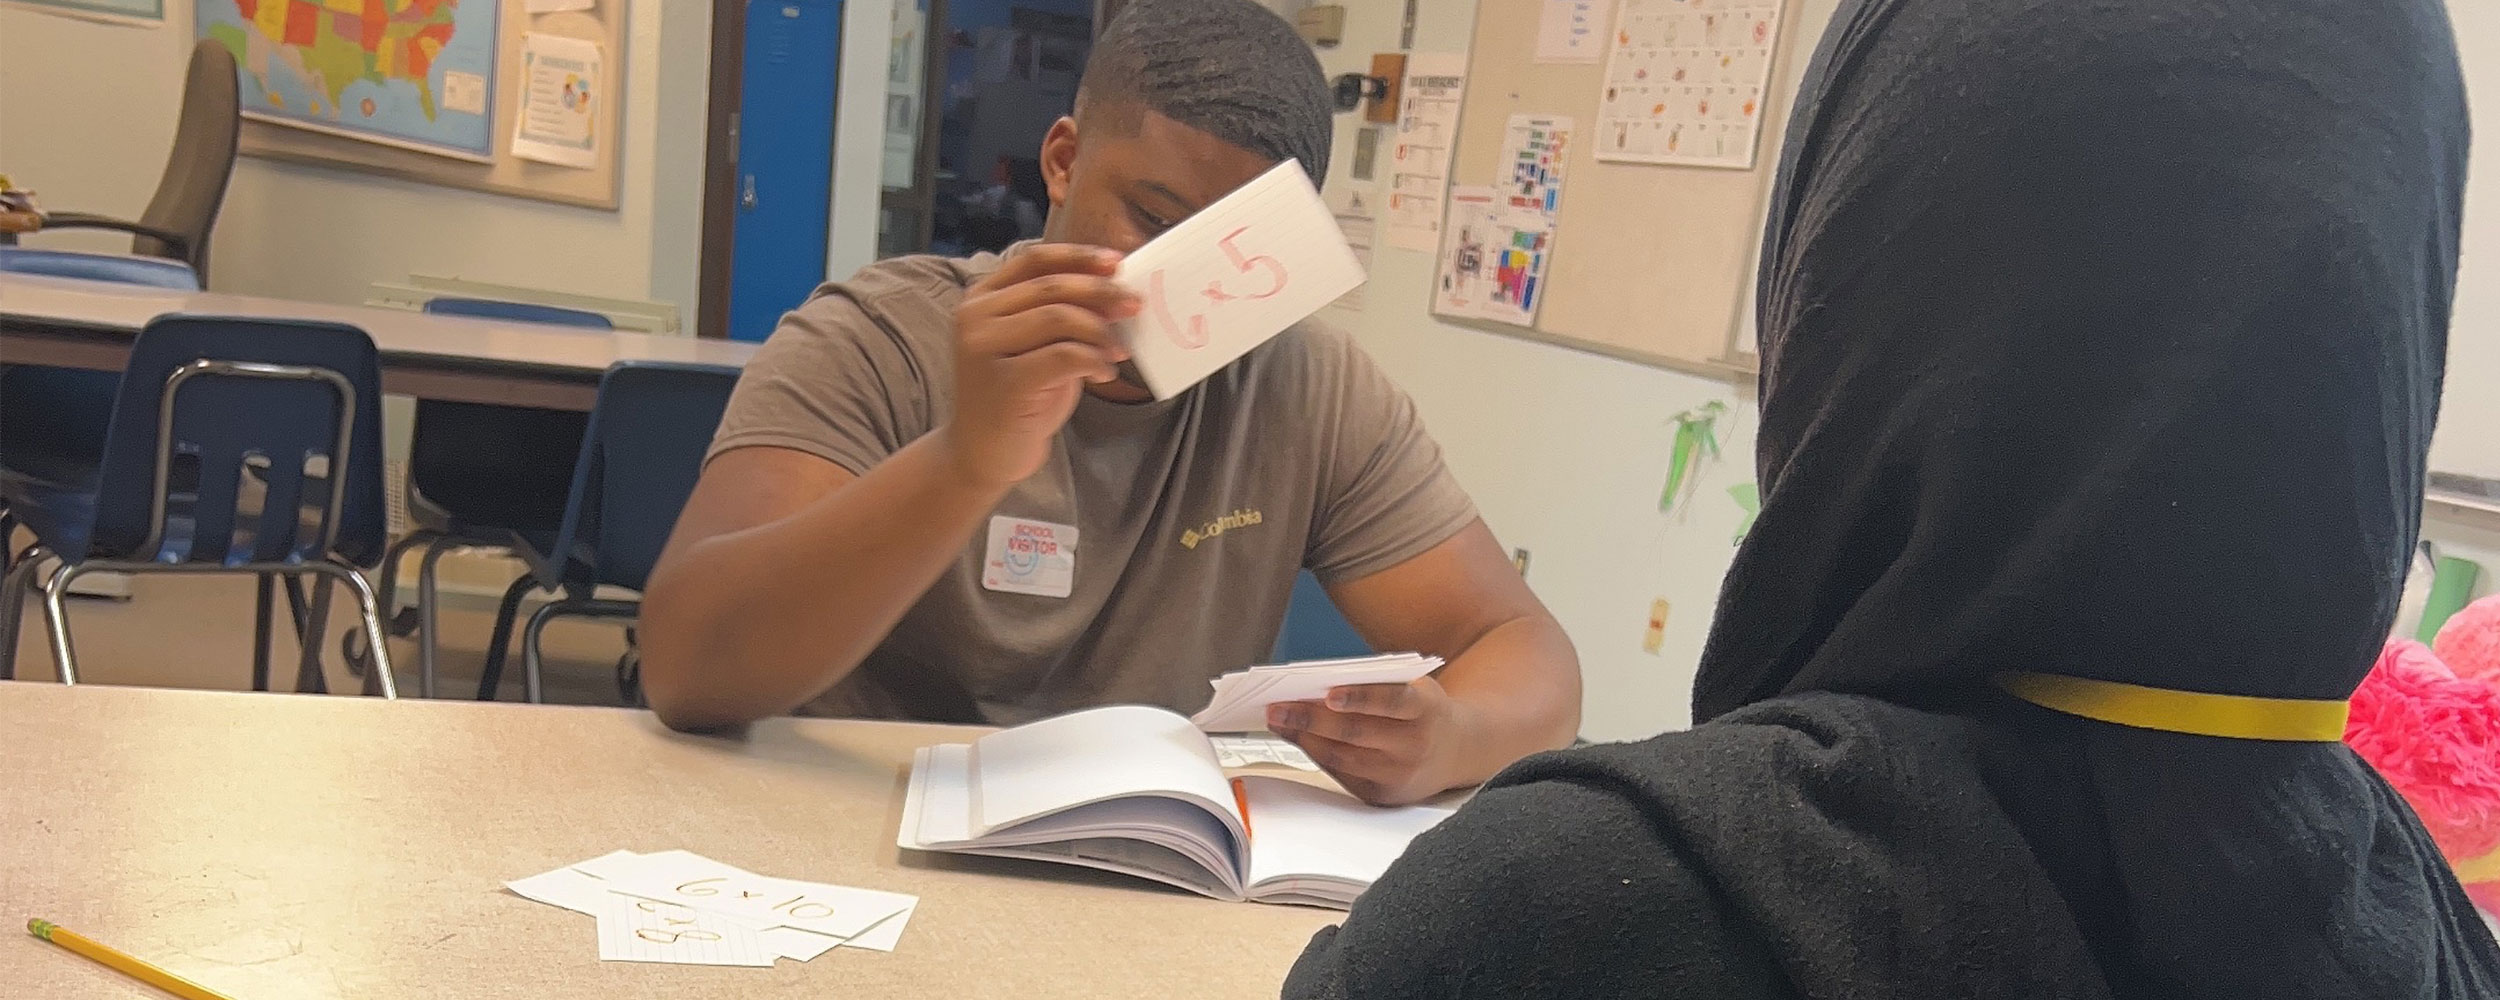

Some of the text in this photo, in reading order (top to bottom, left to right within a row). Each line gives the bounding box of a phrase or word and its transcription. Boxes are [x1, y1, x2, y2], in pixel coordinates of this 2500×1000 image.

[1015, 524, 1054, 538] SCHOOL
[1200, 509, 1262, 540] Colmbia
[1008, 536, 1057, 555] VISITOR
